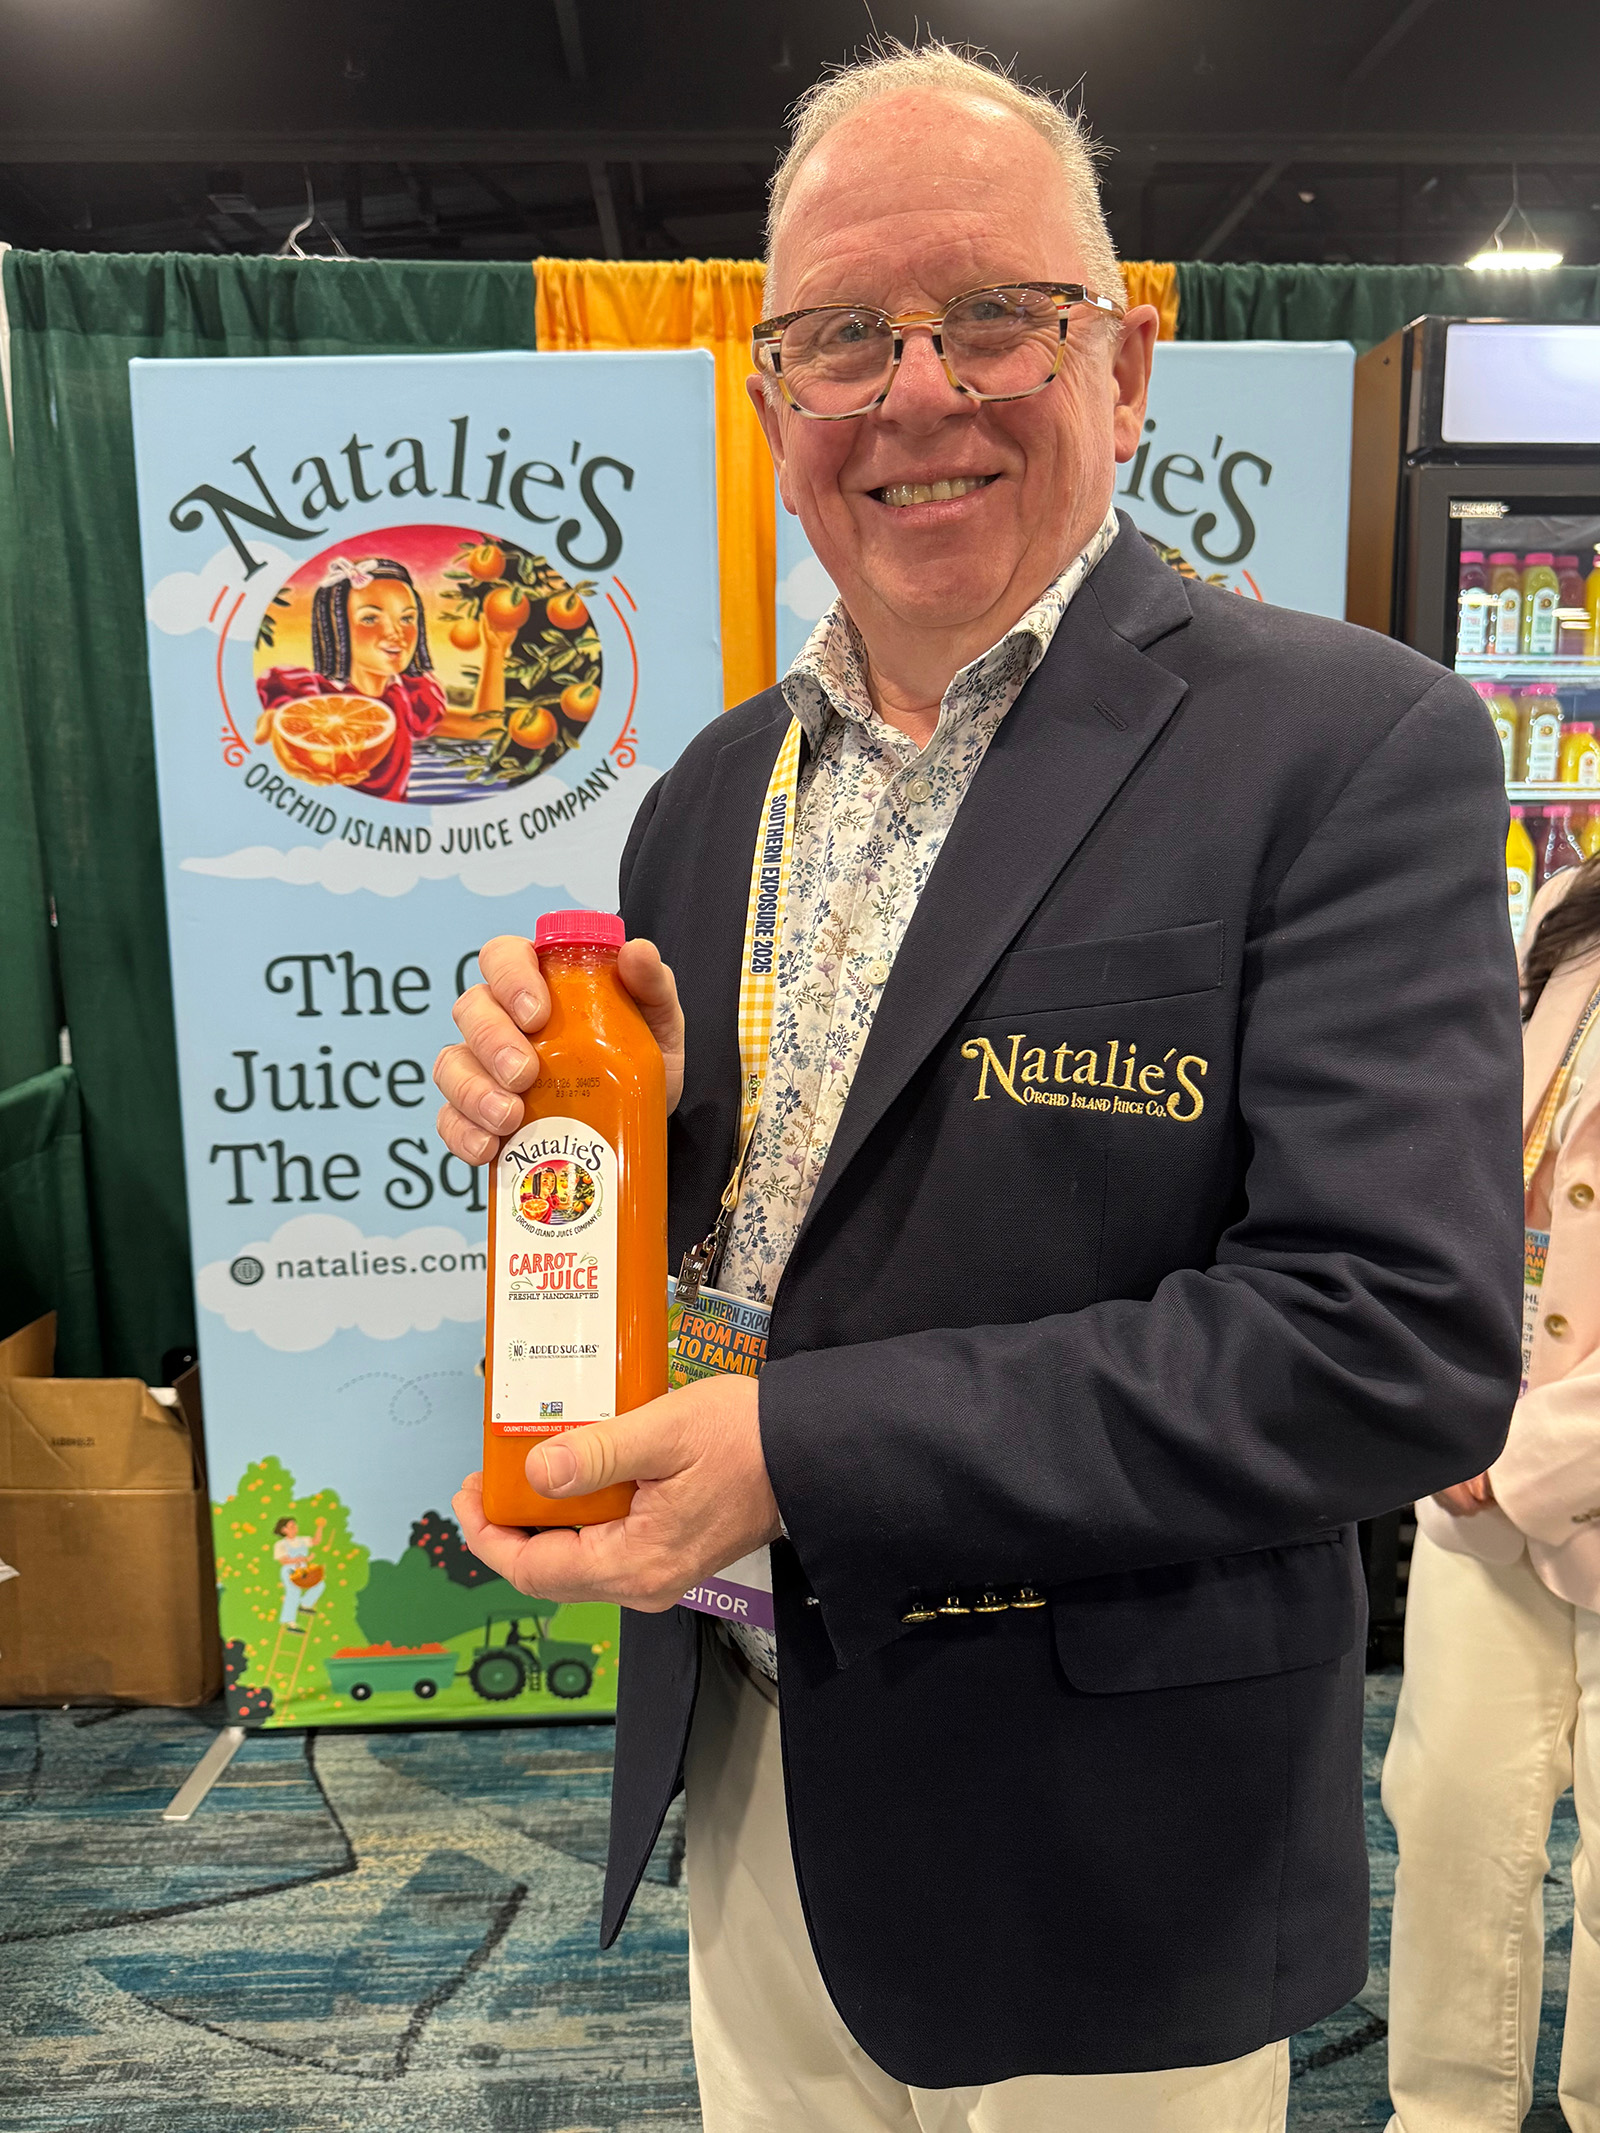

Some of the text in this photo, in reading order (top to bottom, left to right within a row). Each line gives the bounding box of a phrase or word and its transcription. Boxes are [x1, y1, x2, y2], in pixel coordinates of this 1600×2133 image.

[245, 759, 620, 855] ORCHID ISLAND JUICE COMPANY
[751, 793, 788, 973] SOUTHERN EXPOSURE 2026
[265, 951, 431, 1016] The
[214, 1045, 427, 1113] Juice
[209, 1139, 361, 1204] The
[515, 1214, 598, 1238] ORCHID ISLAND JUICE COMPANY
[277, 1251, 487, 1279] natalies.com
[509, 1252, 578, 1277] CARROT
[536, 1265, 598, 1290] JUICE
[508, 1292, 600, 1301] FRESHLY HANDCRAFTED
[685, 1296, 771, 1333] OUTHERN EXPO
[513, 1345, 524, 1356] NO
[529, 1345, 560, 1354] ADDED
[681, 1314, 768, 1359] FROM FIEL
[677, 1335, 766, 1379] TO FAMIL
